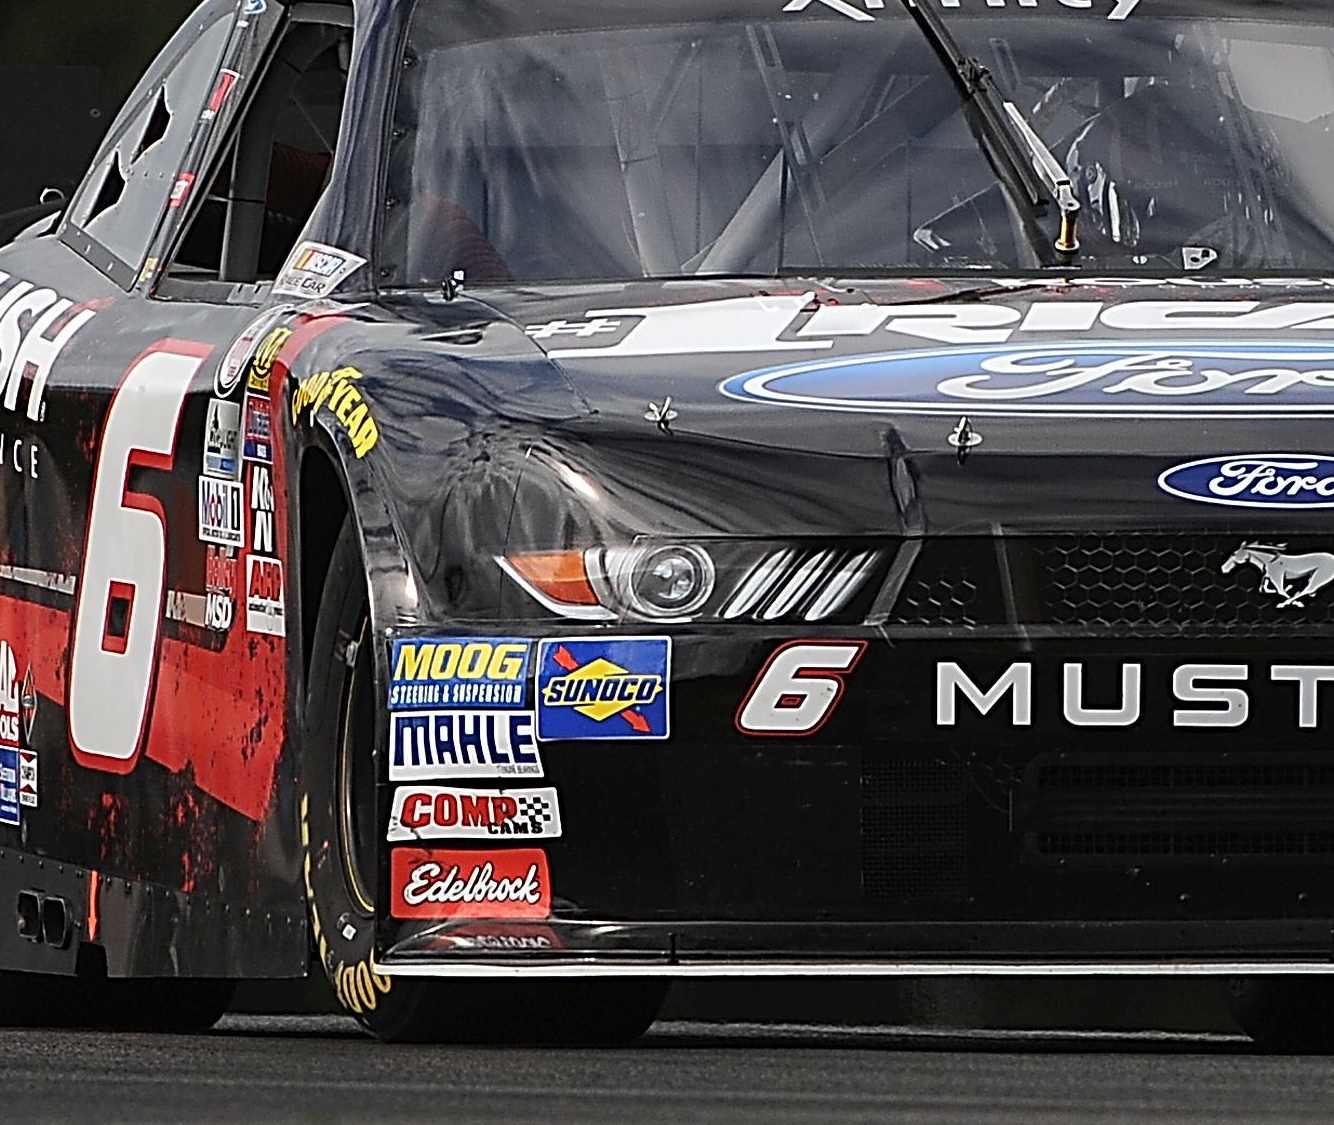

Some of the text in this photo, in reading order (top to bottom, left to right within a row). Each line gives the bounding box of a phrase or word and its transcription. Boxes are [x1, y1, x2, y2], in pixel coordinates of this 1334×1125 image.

[301, 277, 326, 292] CAR
[69, 341, 213, 771] 6
[206, 593, 232, 630] MSD
[393, 644, 528, 681] MOOG
[391, 684, 522, 705] STEERING & SUSPENSION
[546, 676, 660, 703] SUNOCO
[737, 639, 866, 735] 6
[394, 714, 538, 767] MAHLE
[400, 793, 517, 828] COMP
[487, 821, 544, 835] CAMS
[404, 862, 541, 905] Edelbrock
